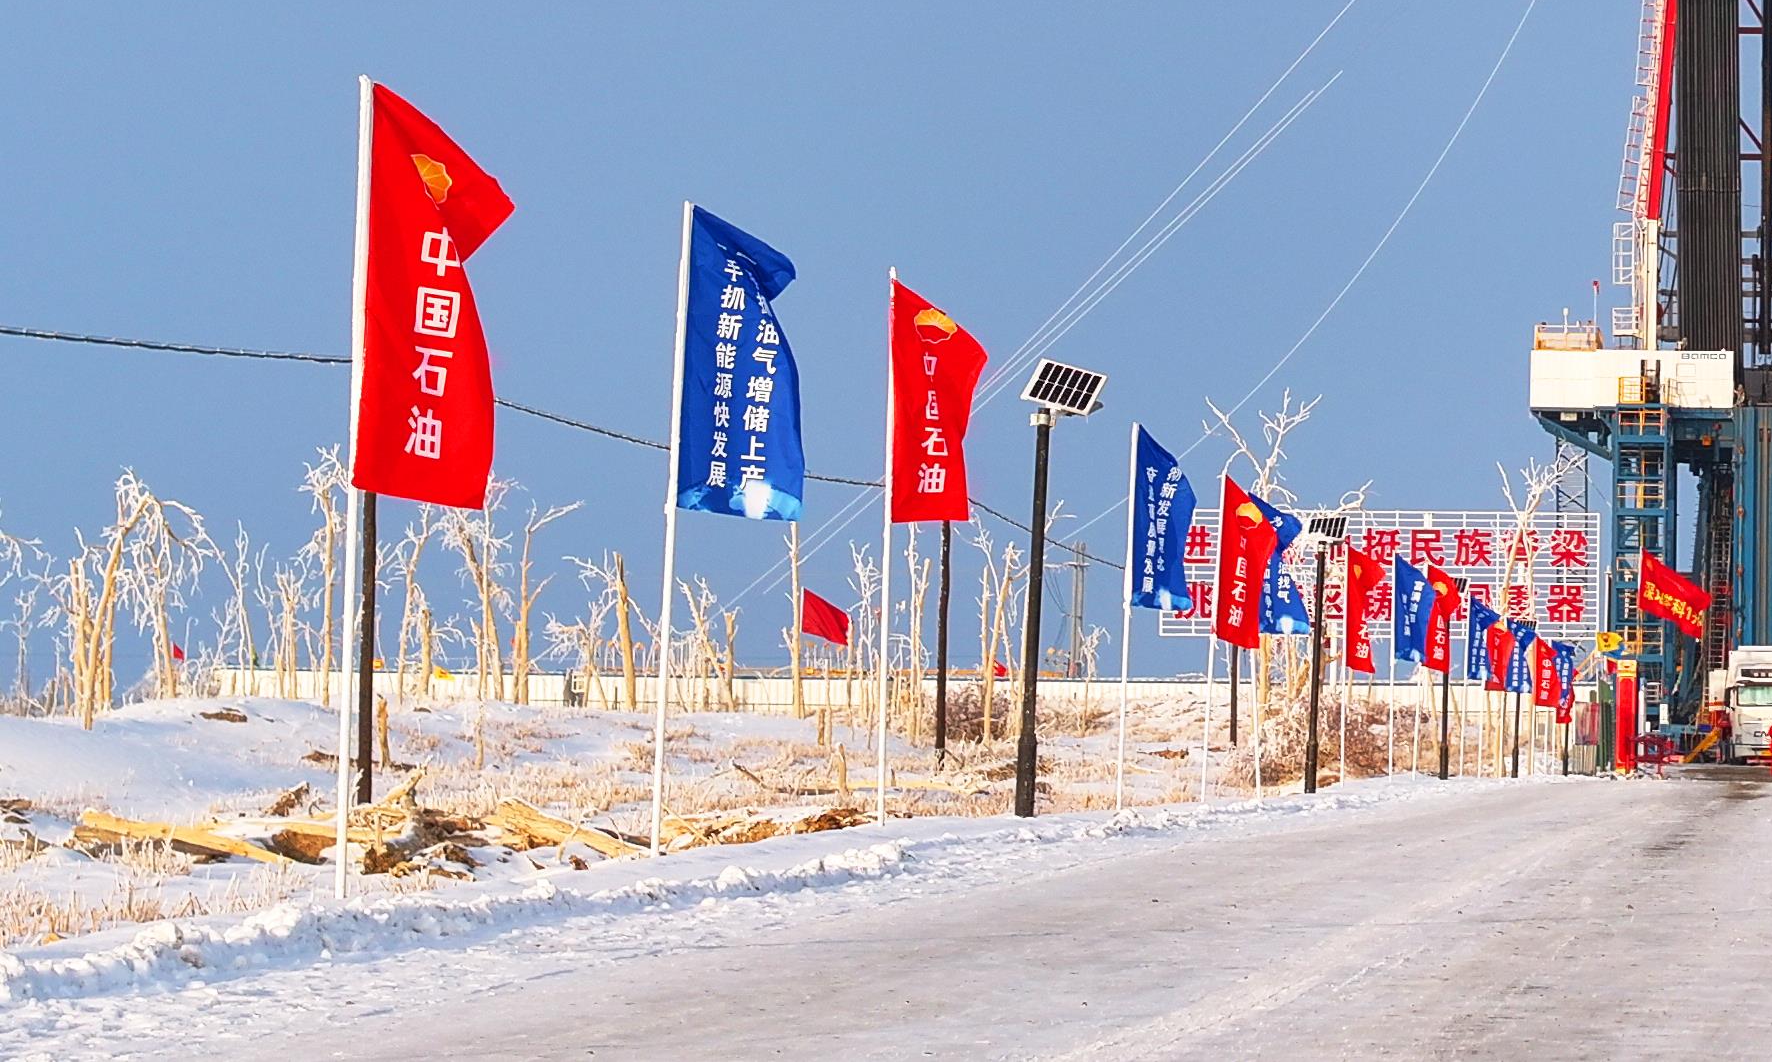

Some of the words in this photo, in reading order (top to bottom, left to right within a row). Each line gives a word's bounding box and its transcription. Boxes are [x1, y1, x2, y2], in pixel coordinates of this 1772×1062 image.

[404, 227, 462, 459] 中国石油
[917, 352, 949, 494] 中国石油
[1227, 535, 1251, 628] 中国石油
